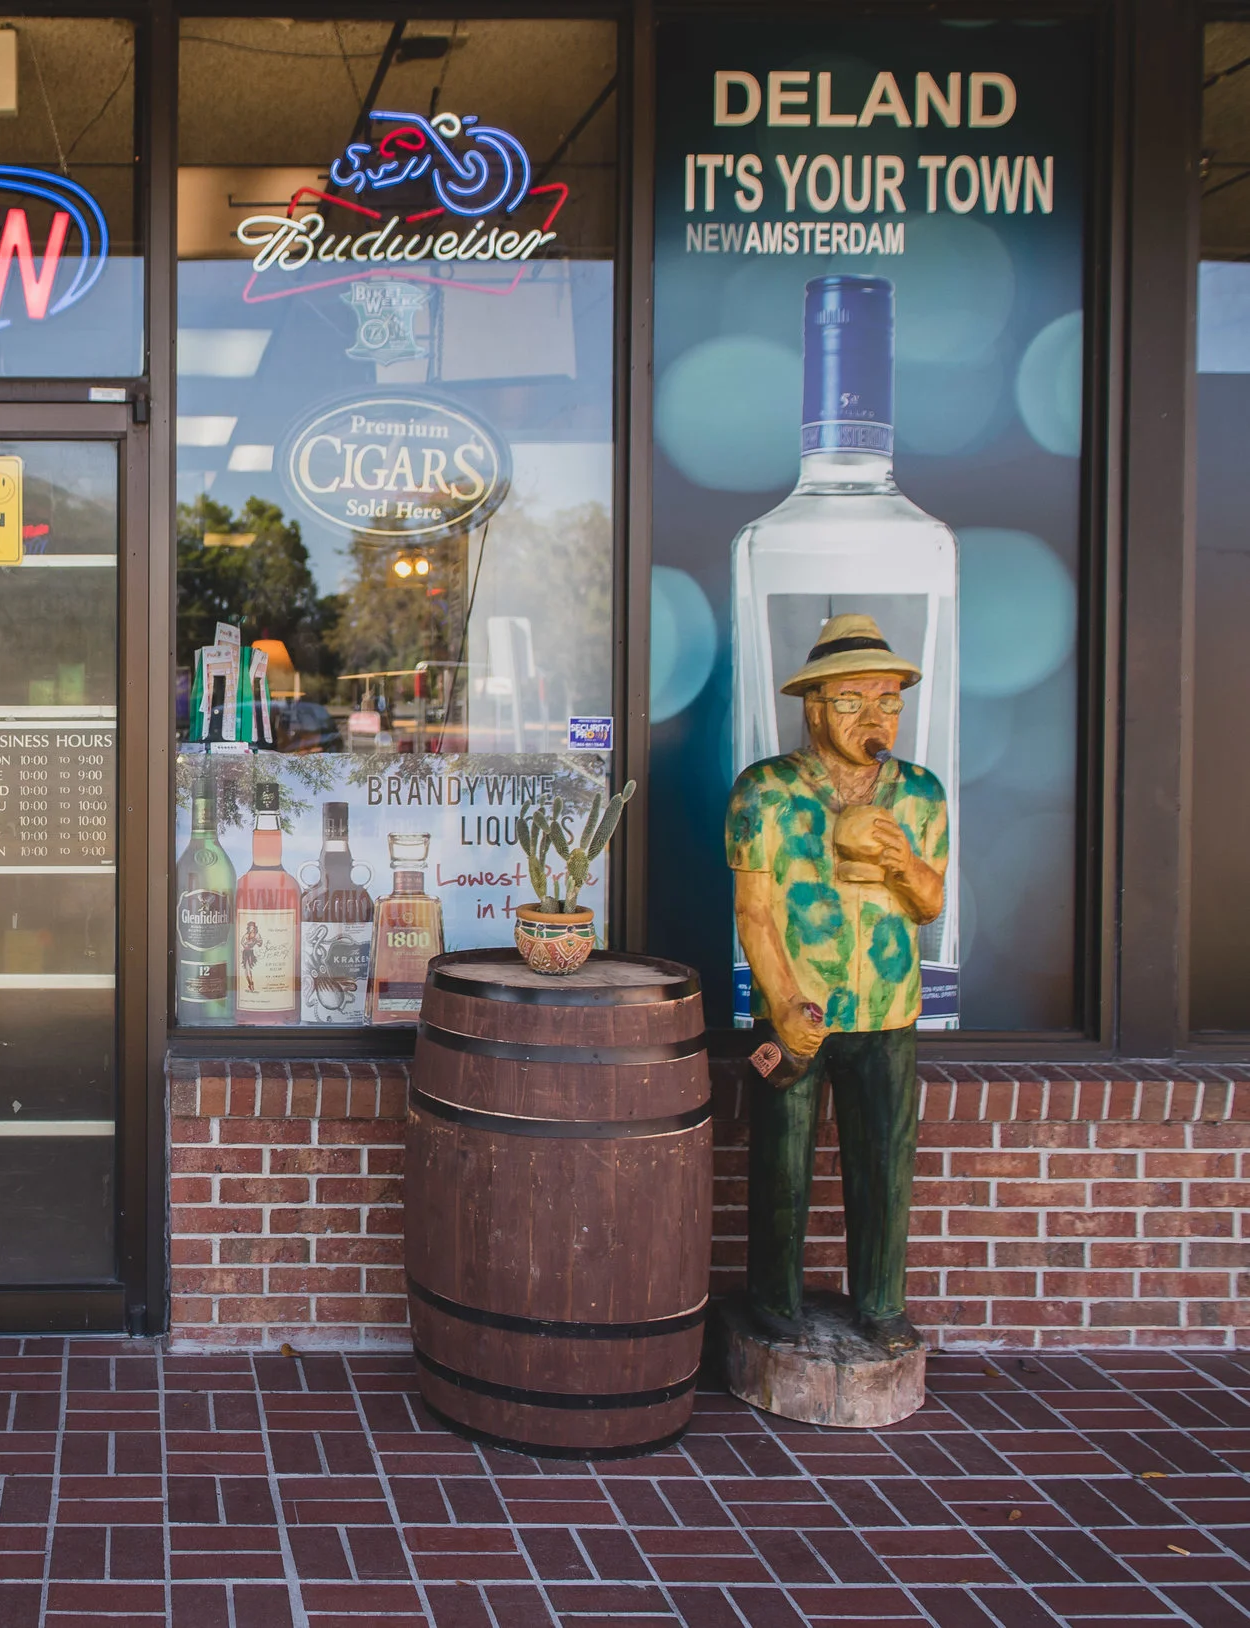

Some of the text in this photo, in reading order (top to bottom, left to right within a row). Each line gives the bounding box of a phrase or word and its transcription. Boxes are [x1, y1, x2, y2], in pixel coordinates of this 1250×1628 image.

[714, 70, 1017, 128] DELAND
[685, 154, 1054, 215] IT'S YOUR TOWN
[237, 212, 557, 272] Budweiser
[350, 415, 449, 439] Premium
[299, 434, 485, 501] CIGARS
[346, 498, 442, 521] Sold Here
[570, 723, 611, 733] SECURITY
[56, 734, 113, 748] HOURS
[20, 755, 48, 765] 10:00
[59, 756, 70, 764] TO
[78, 755, 103, 765] 9:00
[19, 770, 48, 780] 10:00
[60, 771, 70, 779] TO
[78, 770, 102, 780] 9:00
[20, 785, 48, 796] 10:00
[78, 785, 103, 796] 9:00
[366, 775, 555, 806] BRANDYWINE
[19, 800, 48, 811] 10:00
[79, 800, 107, 811] 10:00
[19, 816, 48, 826] 10:00
[78, 816, 106, 826] 10:00
[20, 831, 48, 841] 10:00
[60, 832, 70, 840] TO
[78, 831, 107, 841] 10:00
[461, 815, 575, 847] LIQUS
[21, 846, 48, 856] 10:00
[81, 846, 105, 856] 9:00
[437, 862, 527, 887] Lowest
[181, 909, 228, 924] Glenfiddich
[477, 898, 495, 919] in
[386, 931, 430, 948] 1800
[199, 966, 210, 976] 12
